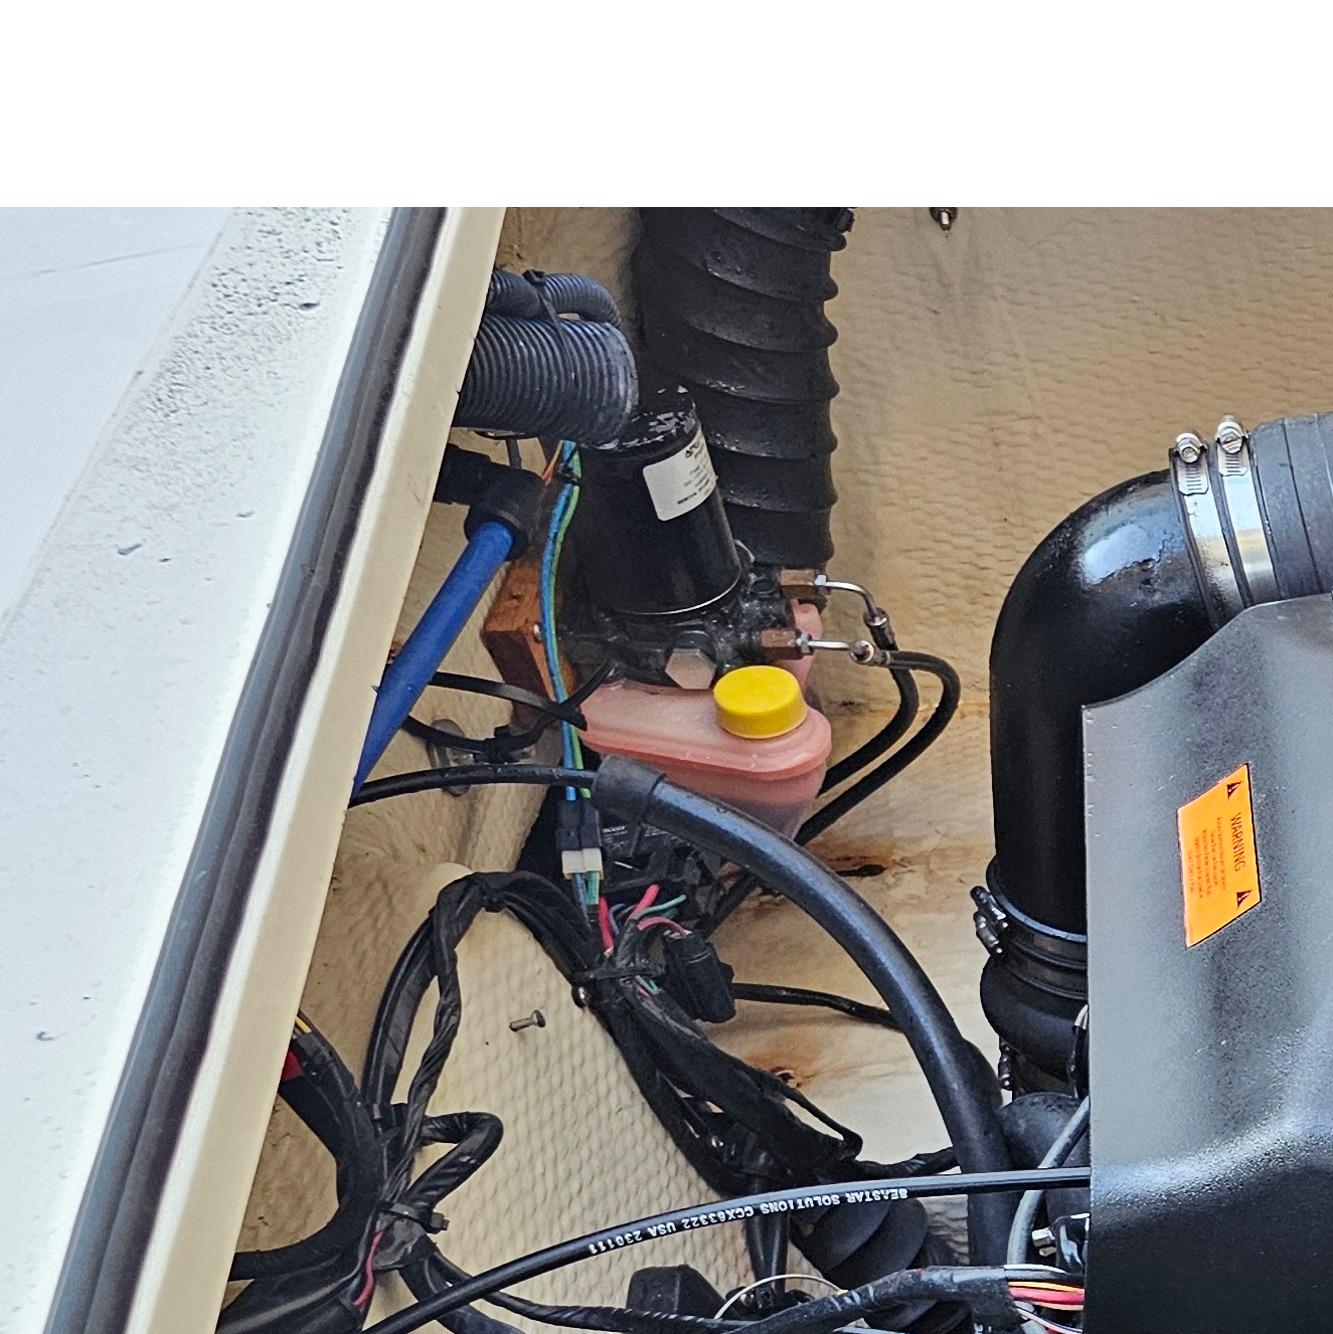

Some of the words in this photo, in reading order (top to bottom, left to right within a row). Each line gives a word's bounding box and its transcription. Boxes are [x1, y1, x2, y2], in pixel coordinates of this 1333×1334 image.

[1230, 811, 1246, 872] WARNING
[759, 1193, 841, 1214] SOLUTIONS
[845, 1188, 908, 1204] SEASTAR
[647, 1222, 676, 1237] USA
[587, 1230, 642, 1255] 230111
